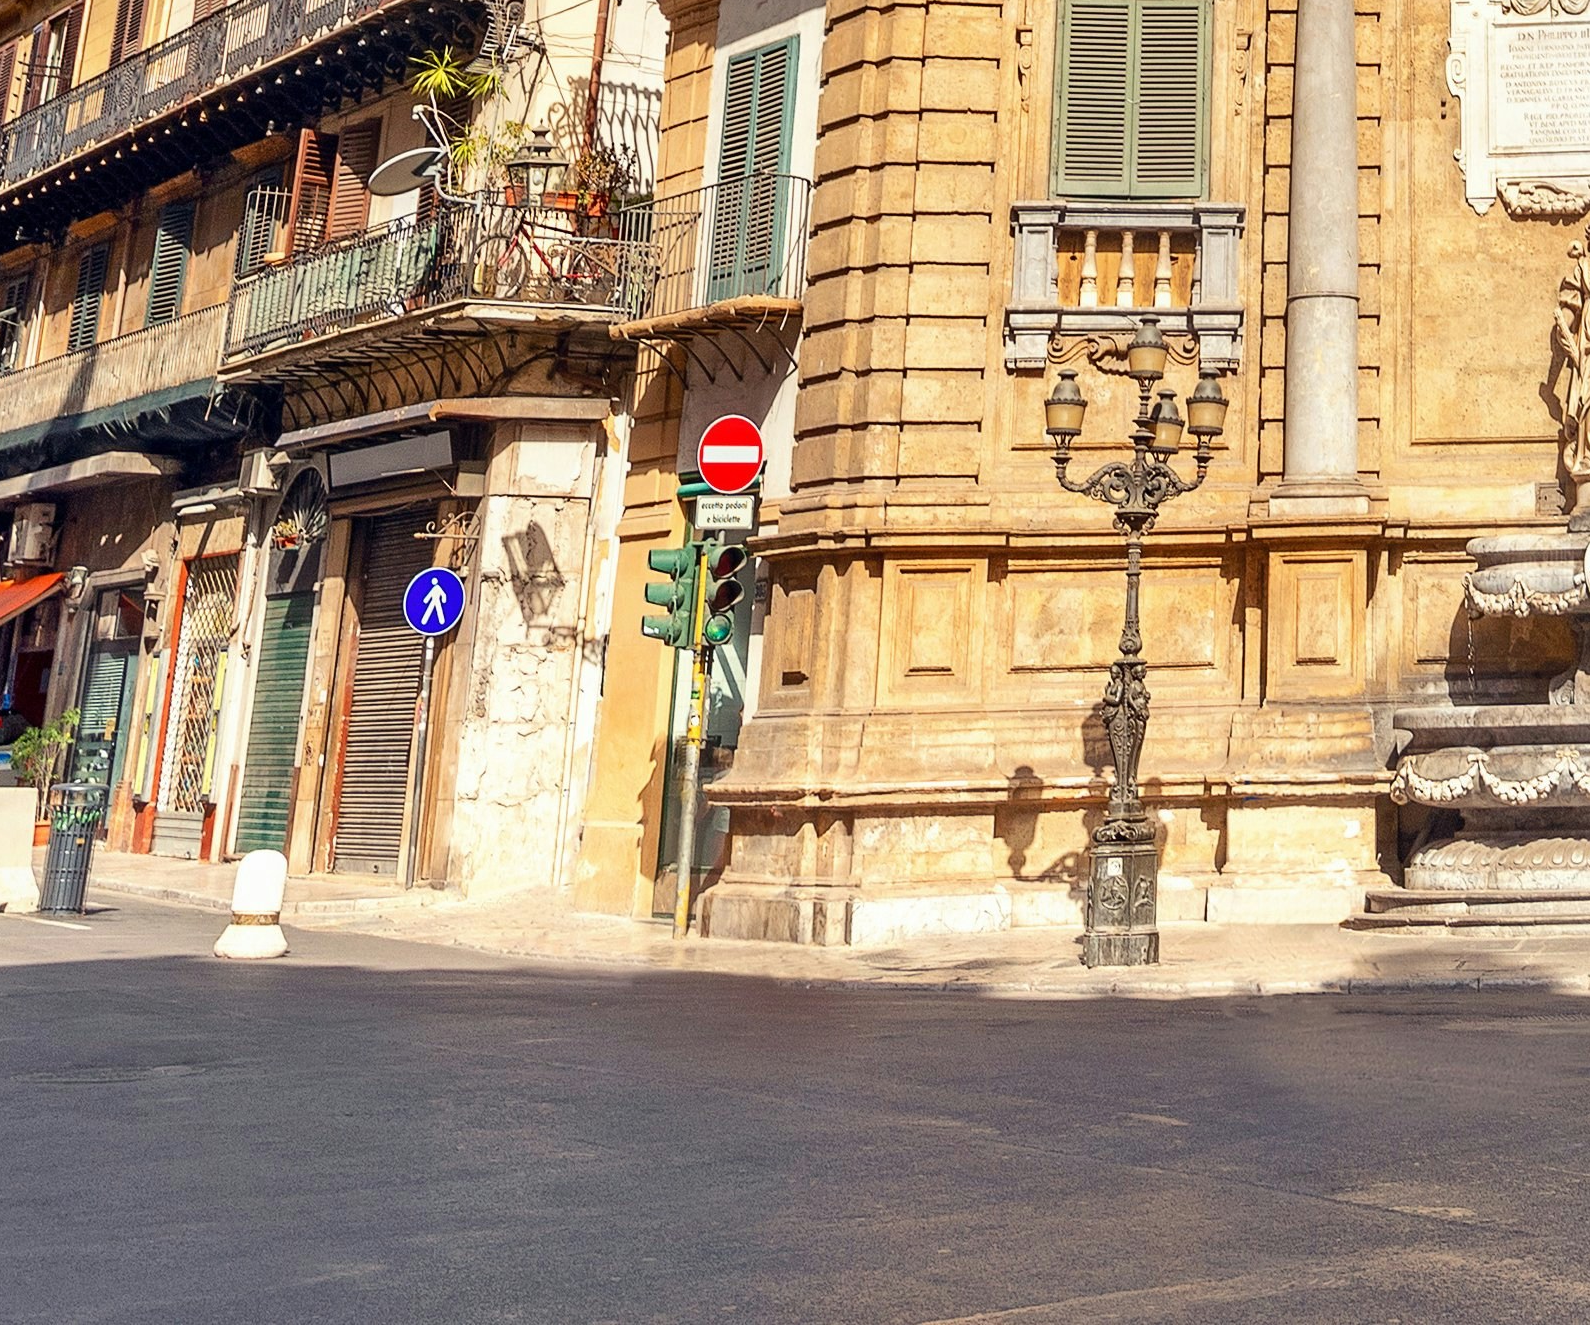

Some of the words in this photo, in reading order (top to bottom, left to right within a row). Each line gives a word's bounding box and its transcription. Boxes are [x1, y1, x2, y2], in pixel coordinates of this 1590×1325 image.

[701, 501, 724, 510] eccetto
[725, 500, 748, 511] pedoni
[712, 514, 741, 524] biciclette
